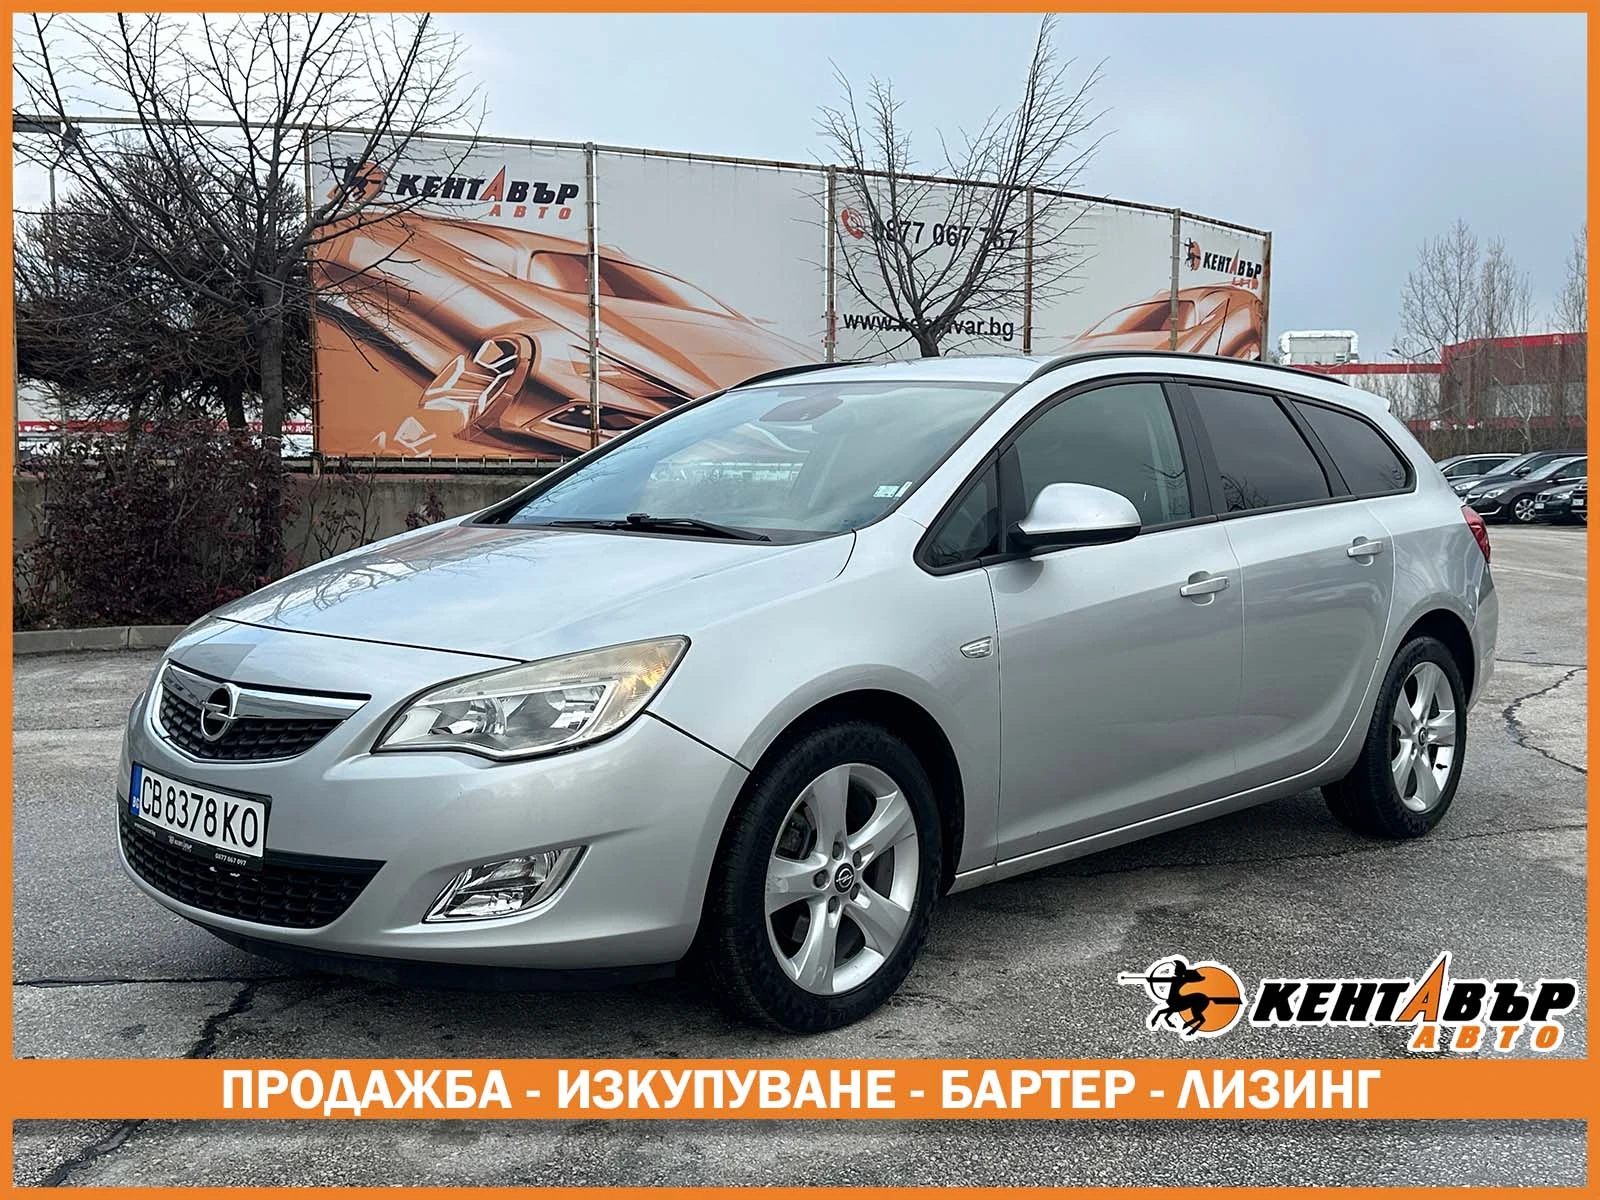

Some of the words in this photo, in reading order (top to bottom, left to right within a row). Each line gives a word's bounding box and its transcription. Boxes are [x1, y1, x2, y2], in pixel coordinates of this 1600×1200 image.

[395, 165, 580, 204] КЕНТАВЪР
[489, 204, 572, 220] АВТО
[871, 219, 925, 244] 877
[933, 222, 972, 247] 067
[1202, 248, 1262, 279] КЕНТАВЪР
[843, 313, 1014, 341] www.kevar.bg
